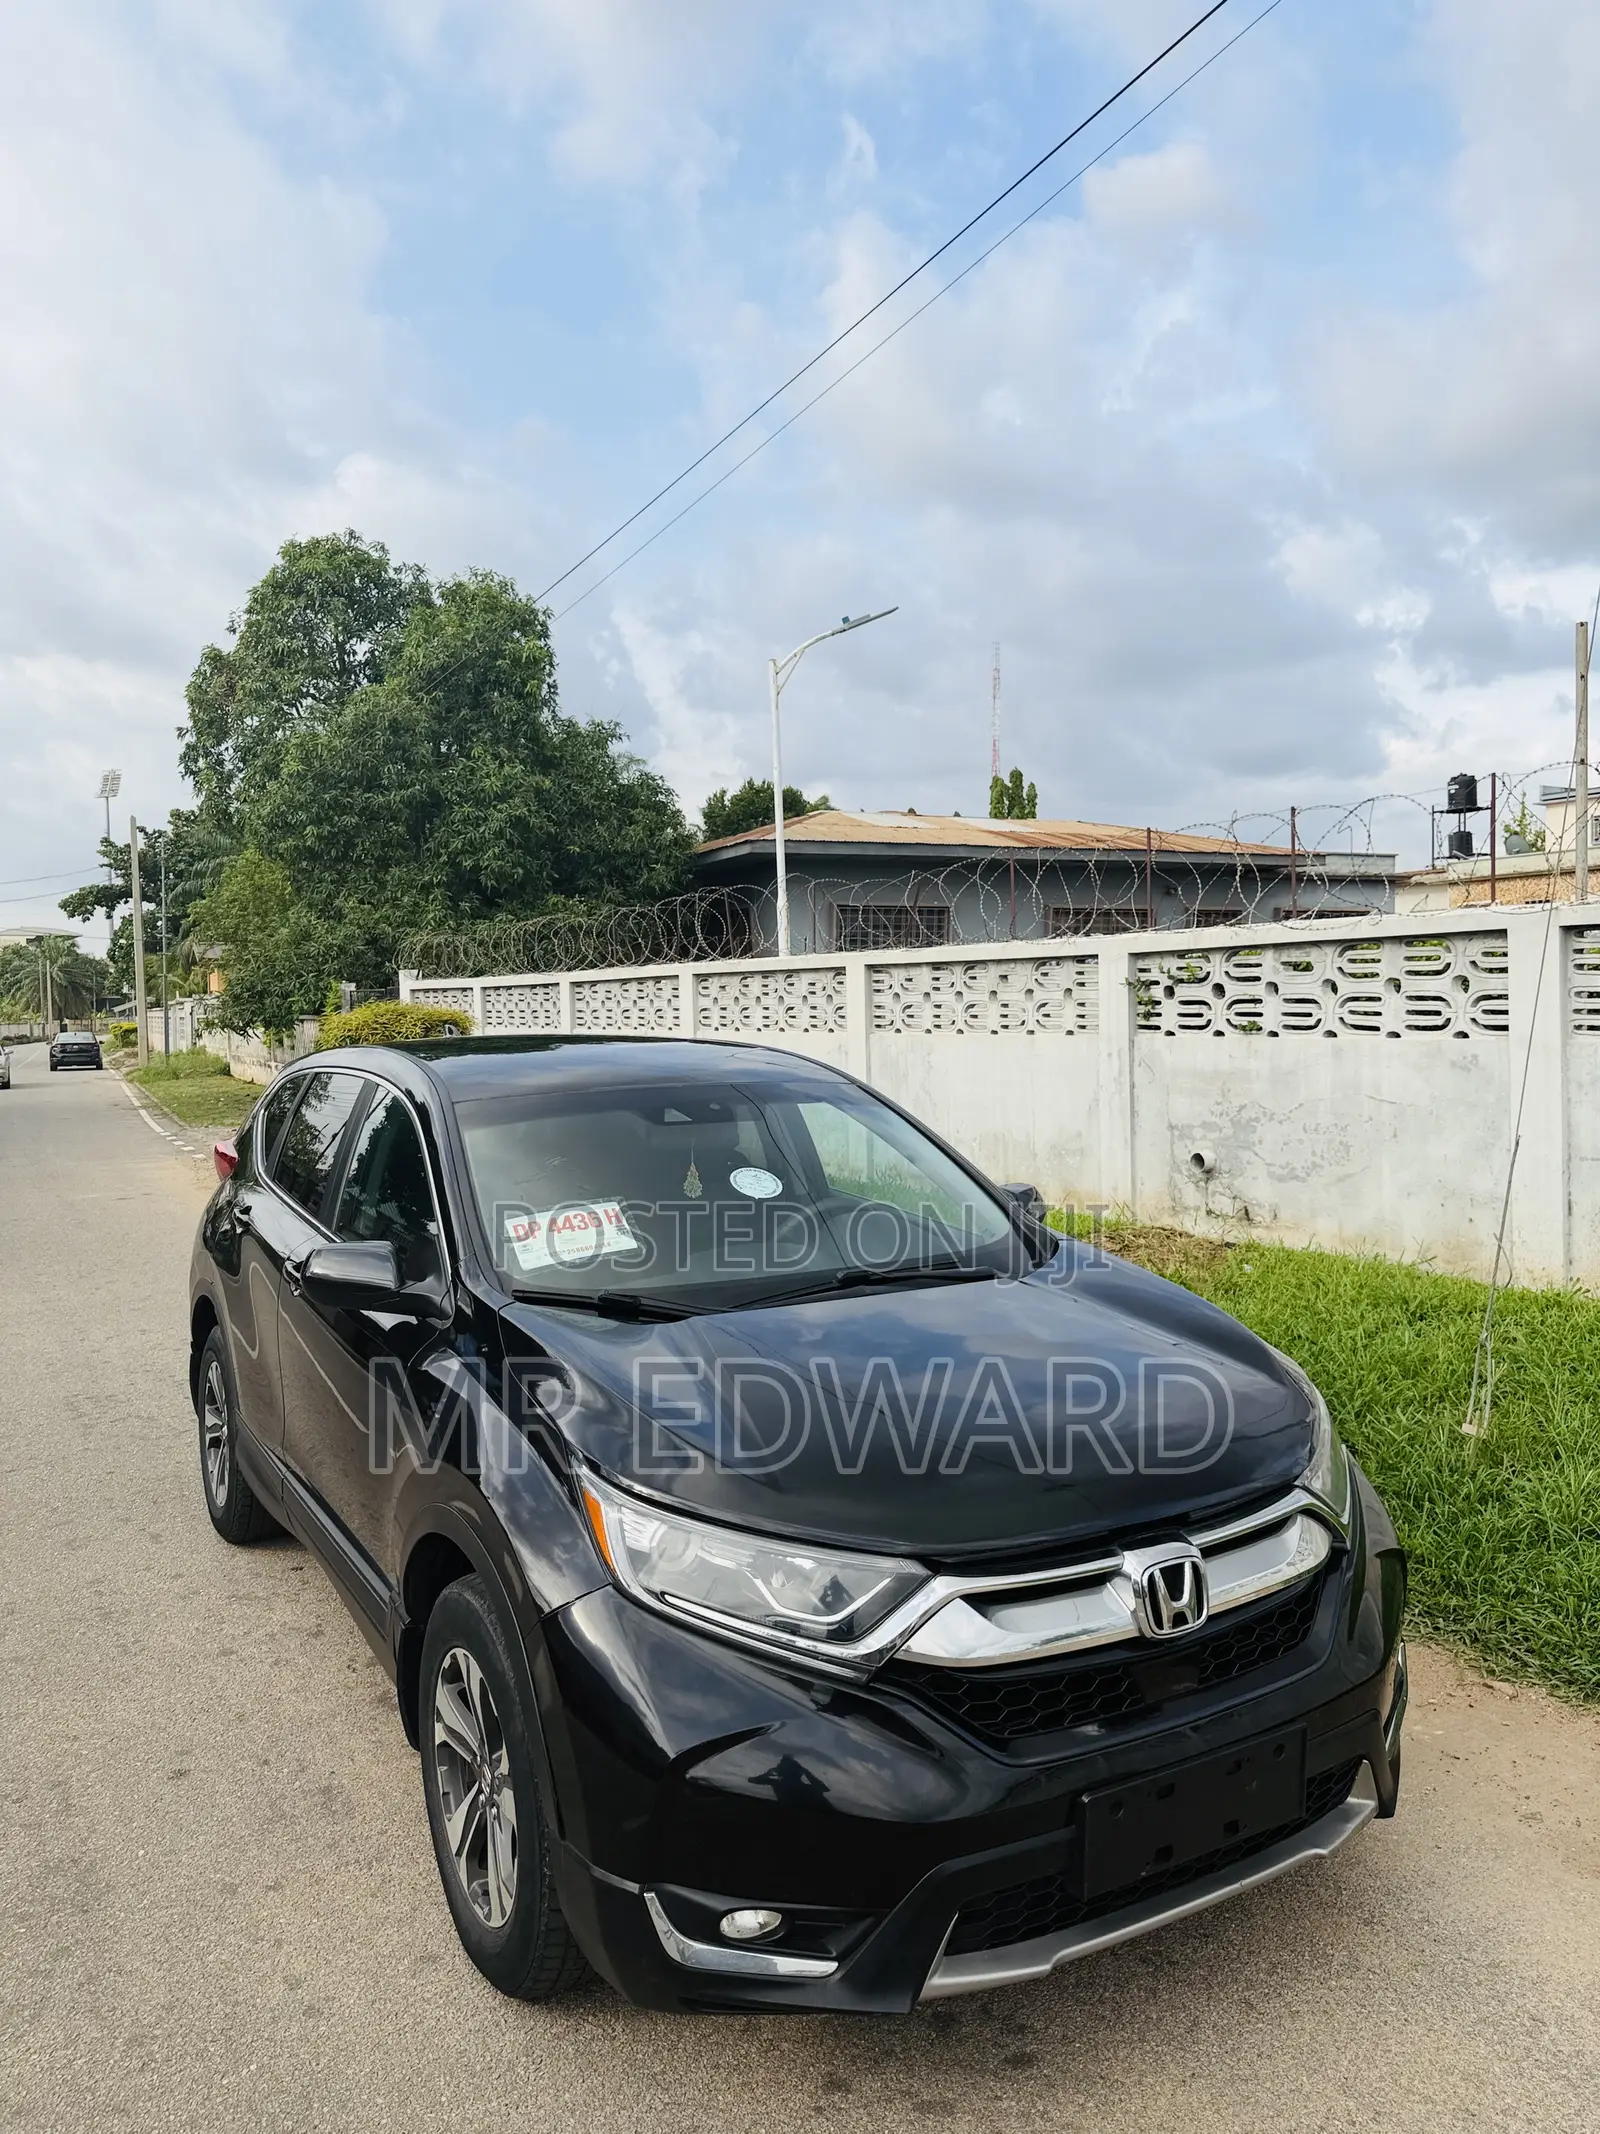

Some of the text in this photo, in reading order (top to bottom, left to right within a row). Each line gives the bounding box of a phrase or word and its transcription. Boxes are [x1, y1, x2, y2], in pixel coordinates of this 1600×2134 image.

[512, 1221, 542, 1242] DP
[548, 1211, 603, 1234] 4436
[603, 1207, 624, 1226] H
